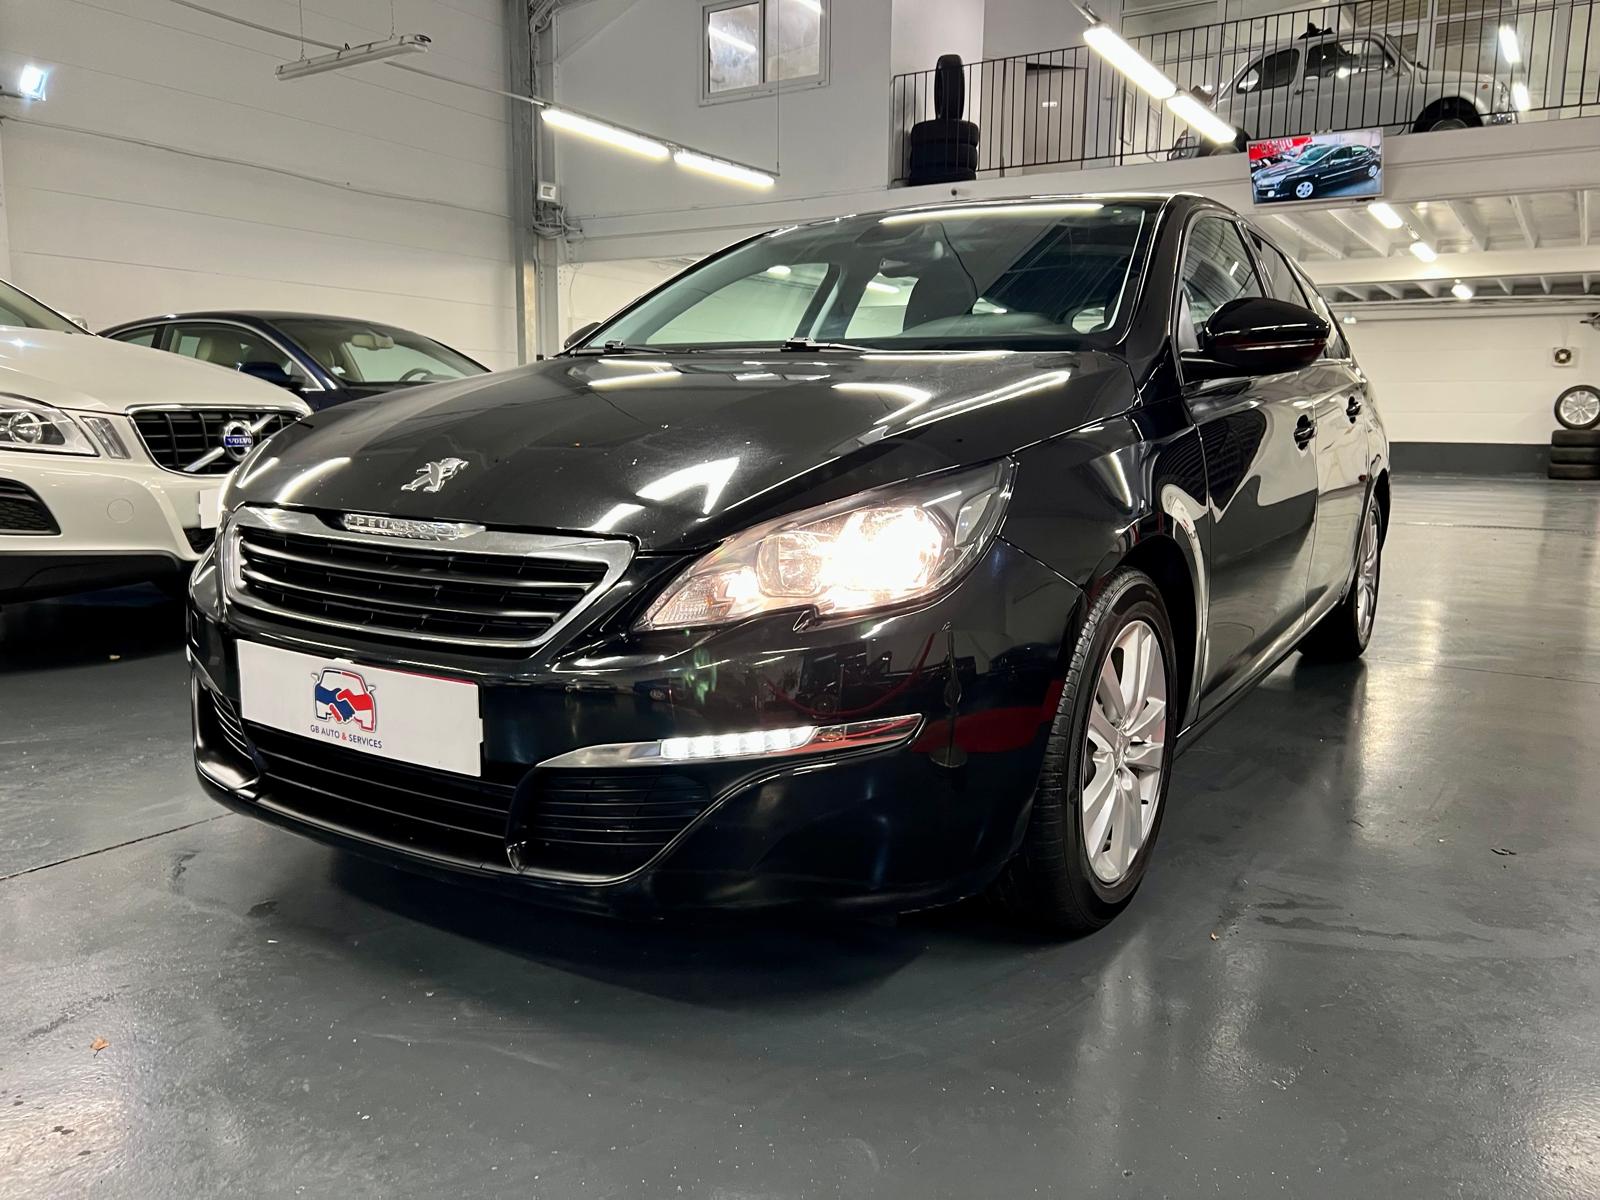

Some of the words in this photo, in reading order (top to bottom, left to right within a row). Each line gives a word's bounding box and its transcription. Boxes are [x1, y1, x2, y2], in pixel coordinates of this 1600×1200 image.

[356, 515, 442, 535] PEUO
[310, 724, 320, 733] GB
[321, 727, 340, 739] AUTO
[341, 732, 347, 741] &
[349, 734, 382, 748] SERVICES
